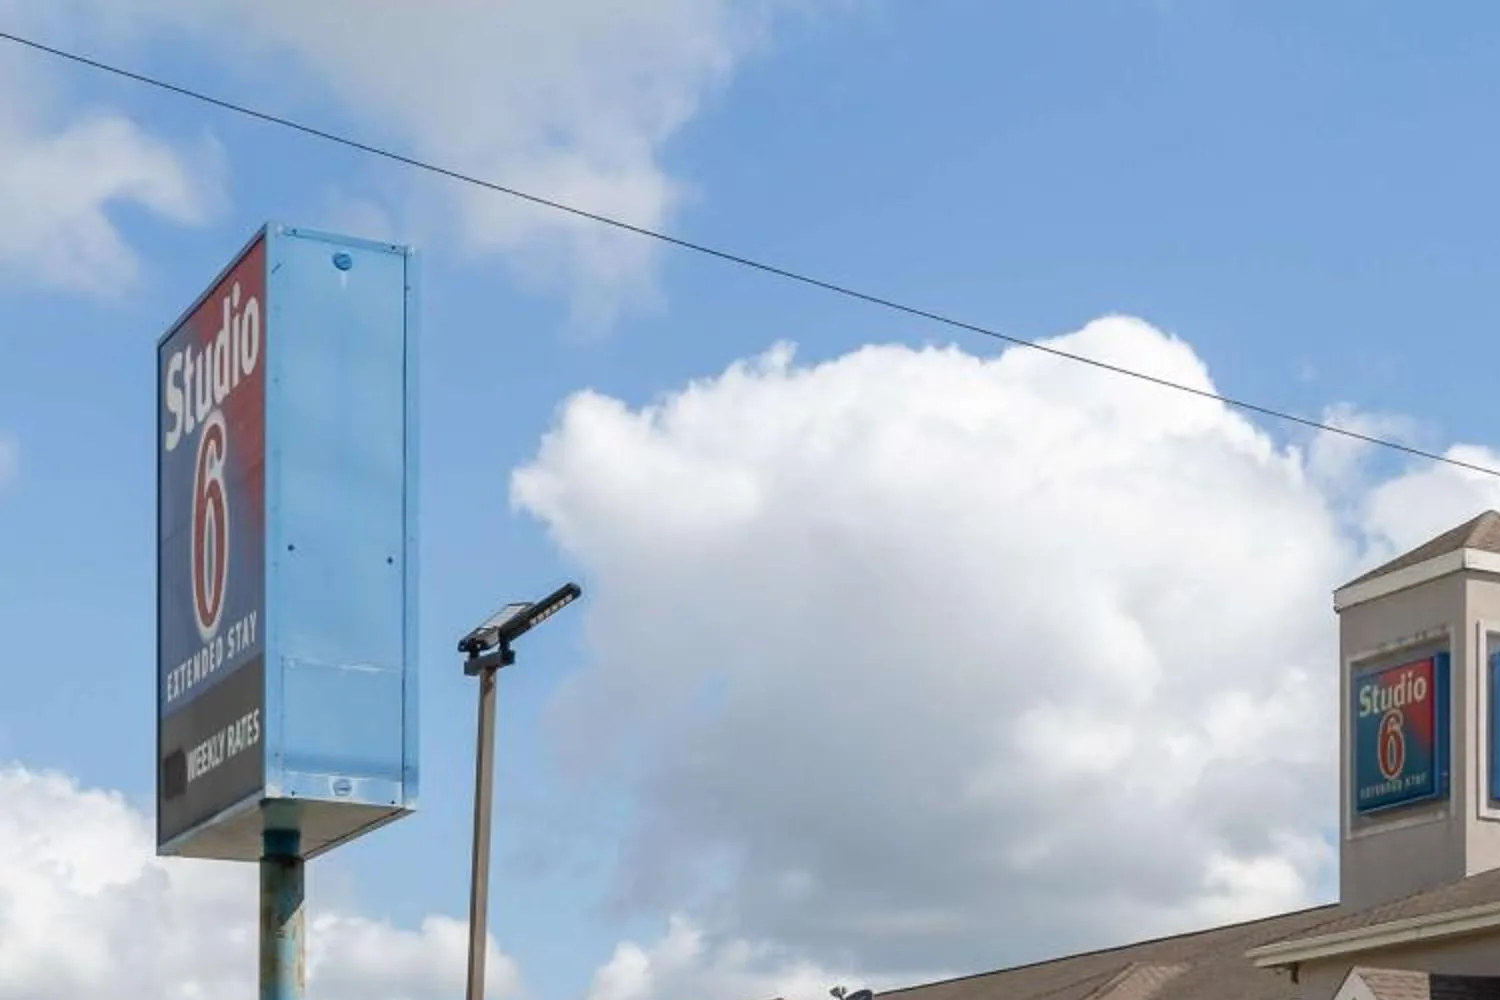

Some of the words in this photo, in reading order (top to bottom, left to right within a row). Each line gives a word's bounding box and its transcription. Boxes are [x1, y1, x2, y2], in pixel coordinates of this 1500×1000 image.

[164, 282, 259, 453] Studio
[191, 410, 230, 639] 6
[167, 637, 223, 703] EXTENDED
[227, 610, 257, 658] STAY
[1359, 670, 1427, 718] Studio
[186, 726, 226, 783] WEEKLY
[227, 708, 260, 758] RATES
[1377, 708, 1406, 780] 6
